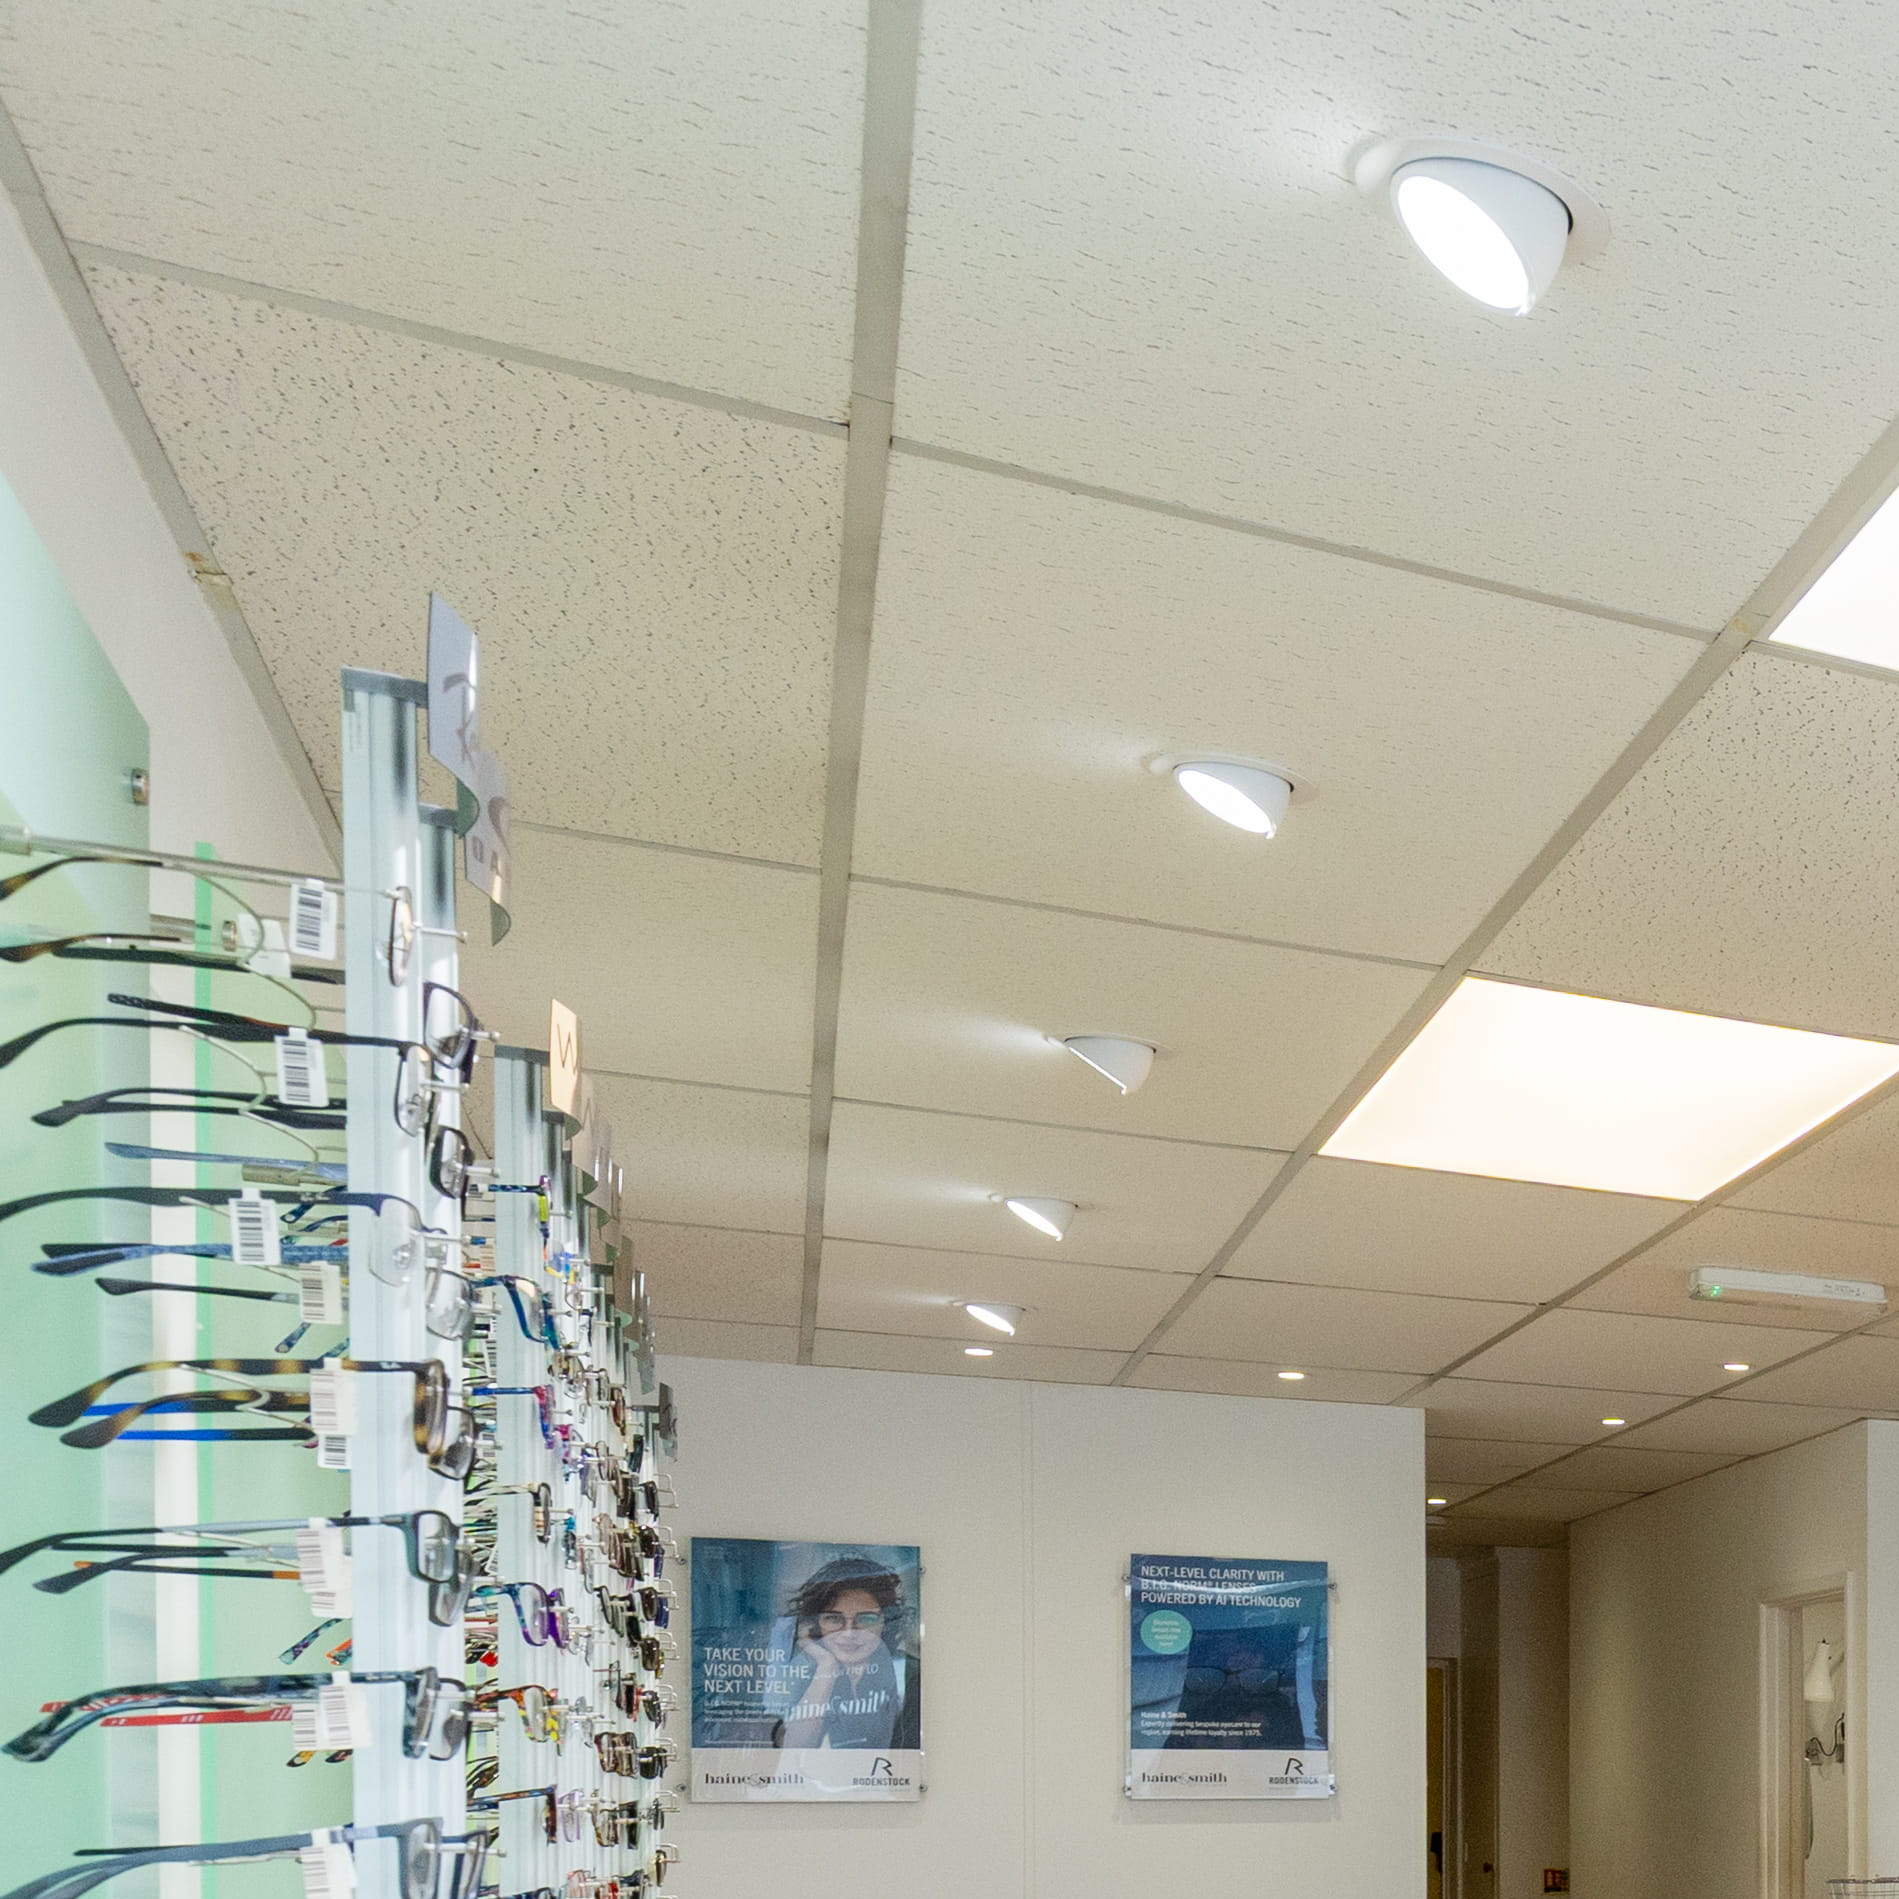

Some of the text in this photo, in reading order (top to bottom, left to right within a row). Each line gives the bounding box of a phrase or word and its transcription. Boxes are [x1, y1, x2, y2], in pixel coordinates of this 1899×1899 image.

[1141, 1566, 1285, 1581] NEXT-LEVEL CLARITY WITH
[1141, 1591, 1302, 1608] POWERED BY AI TECHNOLOGY
[704, 1647, 785, 1662] TAKE YOUR
[704, 1663, 753, 1677] VISION
[757, 1664, 777, 1677] TO
[780, 1665, 810, 1678] THE
[704, 1680, 742, 1694] NEXT
[852, 1777, 910, 1786] RODENSTOCK
[1268, 1776, 1319, 1785] RODENSTOCK
